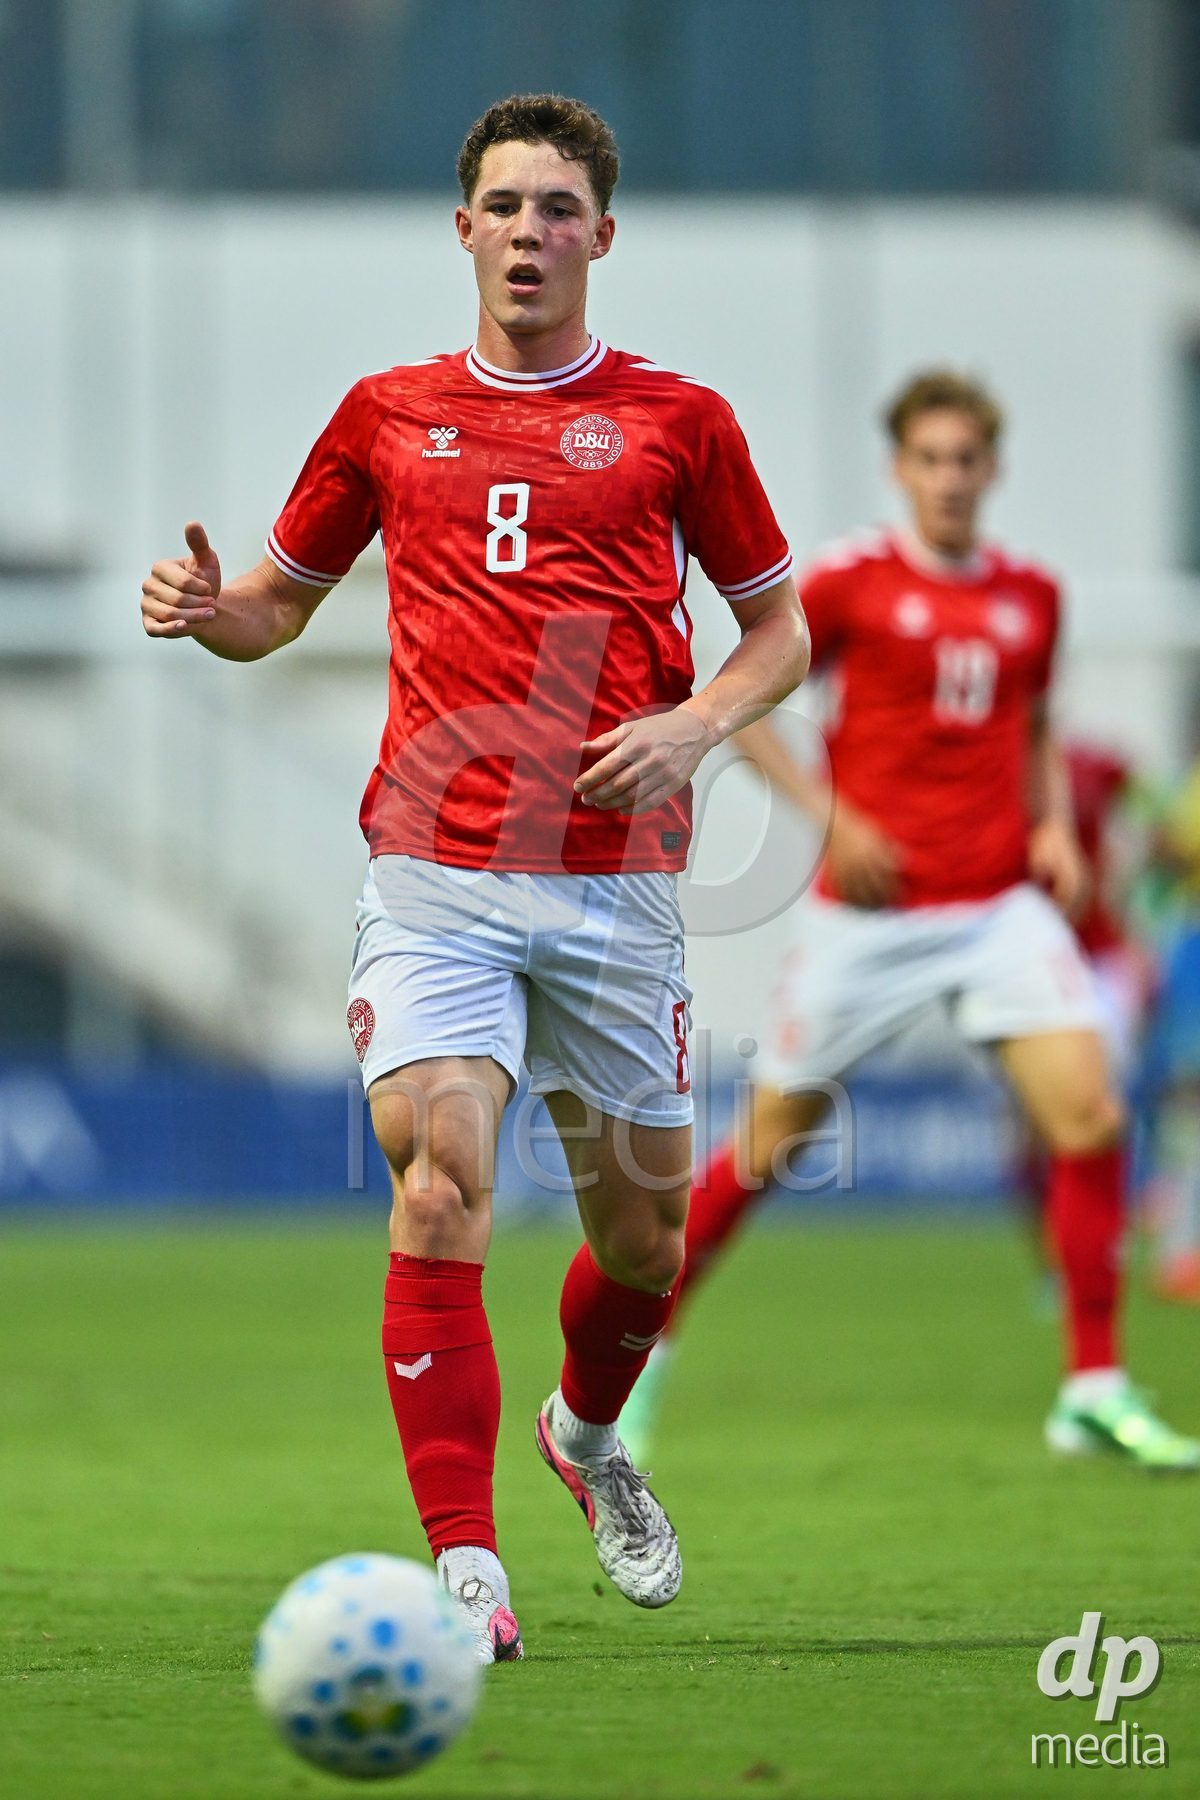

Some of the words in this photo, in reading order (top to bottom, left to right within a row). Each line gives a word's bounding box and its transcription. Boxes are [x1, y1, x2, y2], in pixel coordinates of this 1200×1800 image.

[562, 431, 577, 462] DANSK
[573, 432, 611, 449] DBU
[421, 448, 461, 458] hummel
[577, 460, 603, 468] 1889
[486, 483, 530, 573] 8
[672, 1000, 692, 1094] 8
